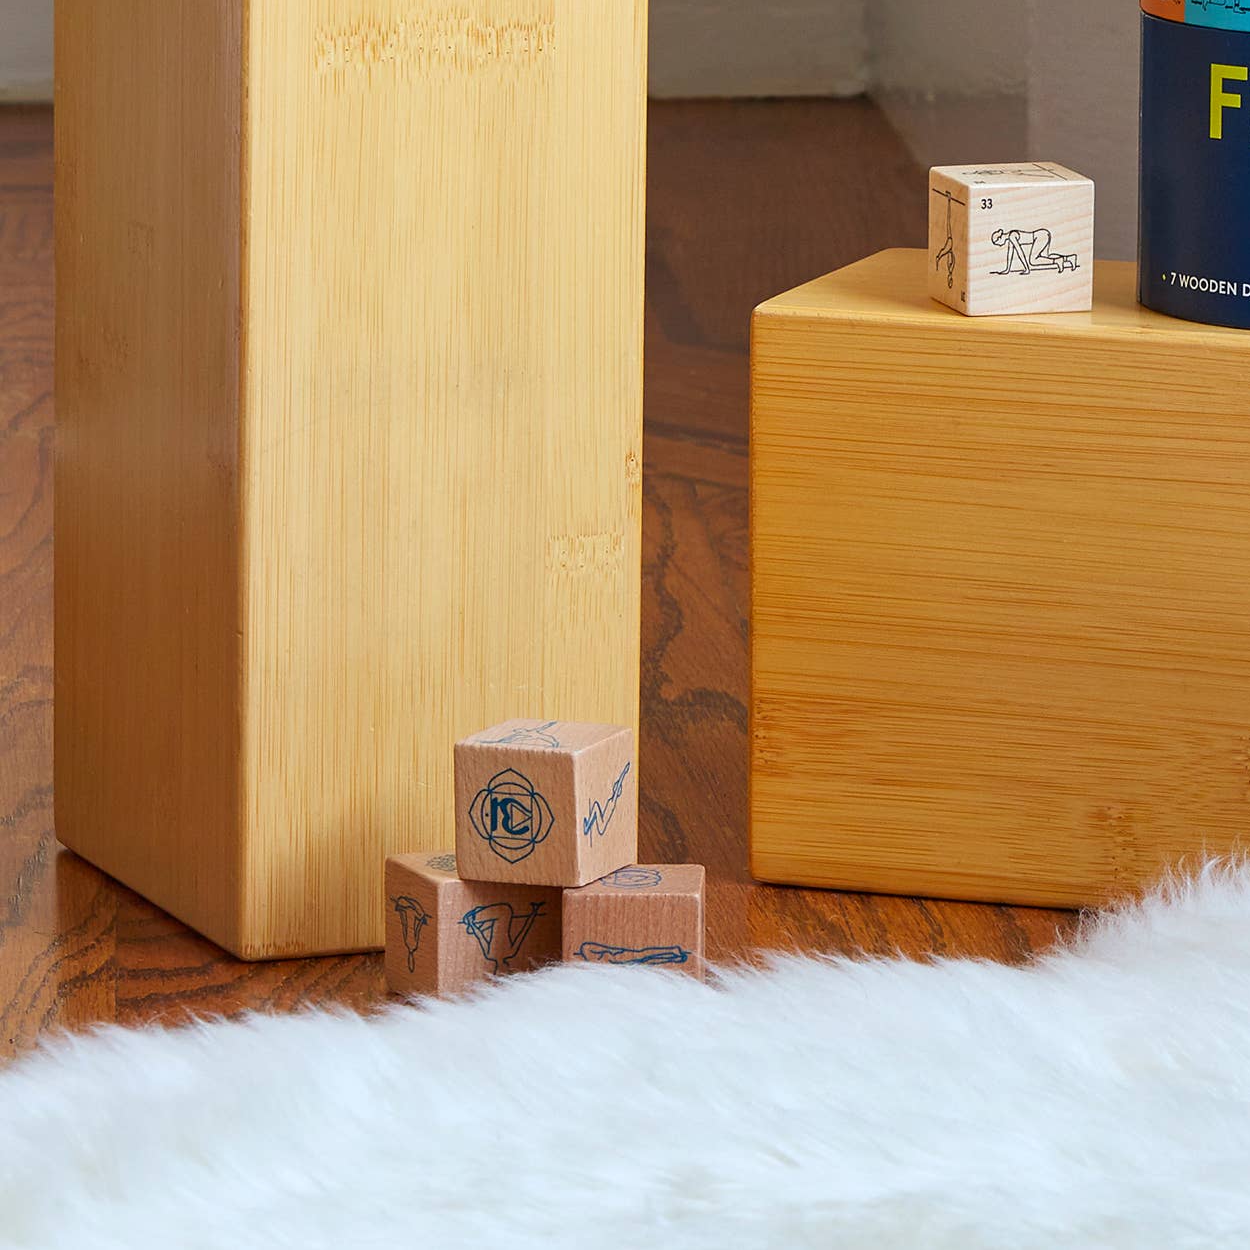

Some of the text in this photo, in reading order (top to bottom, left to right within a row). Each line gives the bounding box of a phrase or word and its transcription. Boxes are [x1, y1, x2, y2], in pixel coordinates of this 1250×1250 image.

[980, 198, 993, 210] 33
[1170, 272, 1177, 286] 7
[1179, 274, 1237, 296] WOODEN
